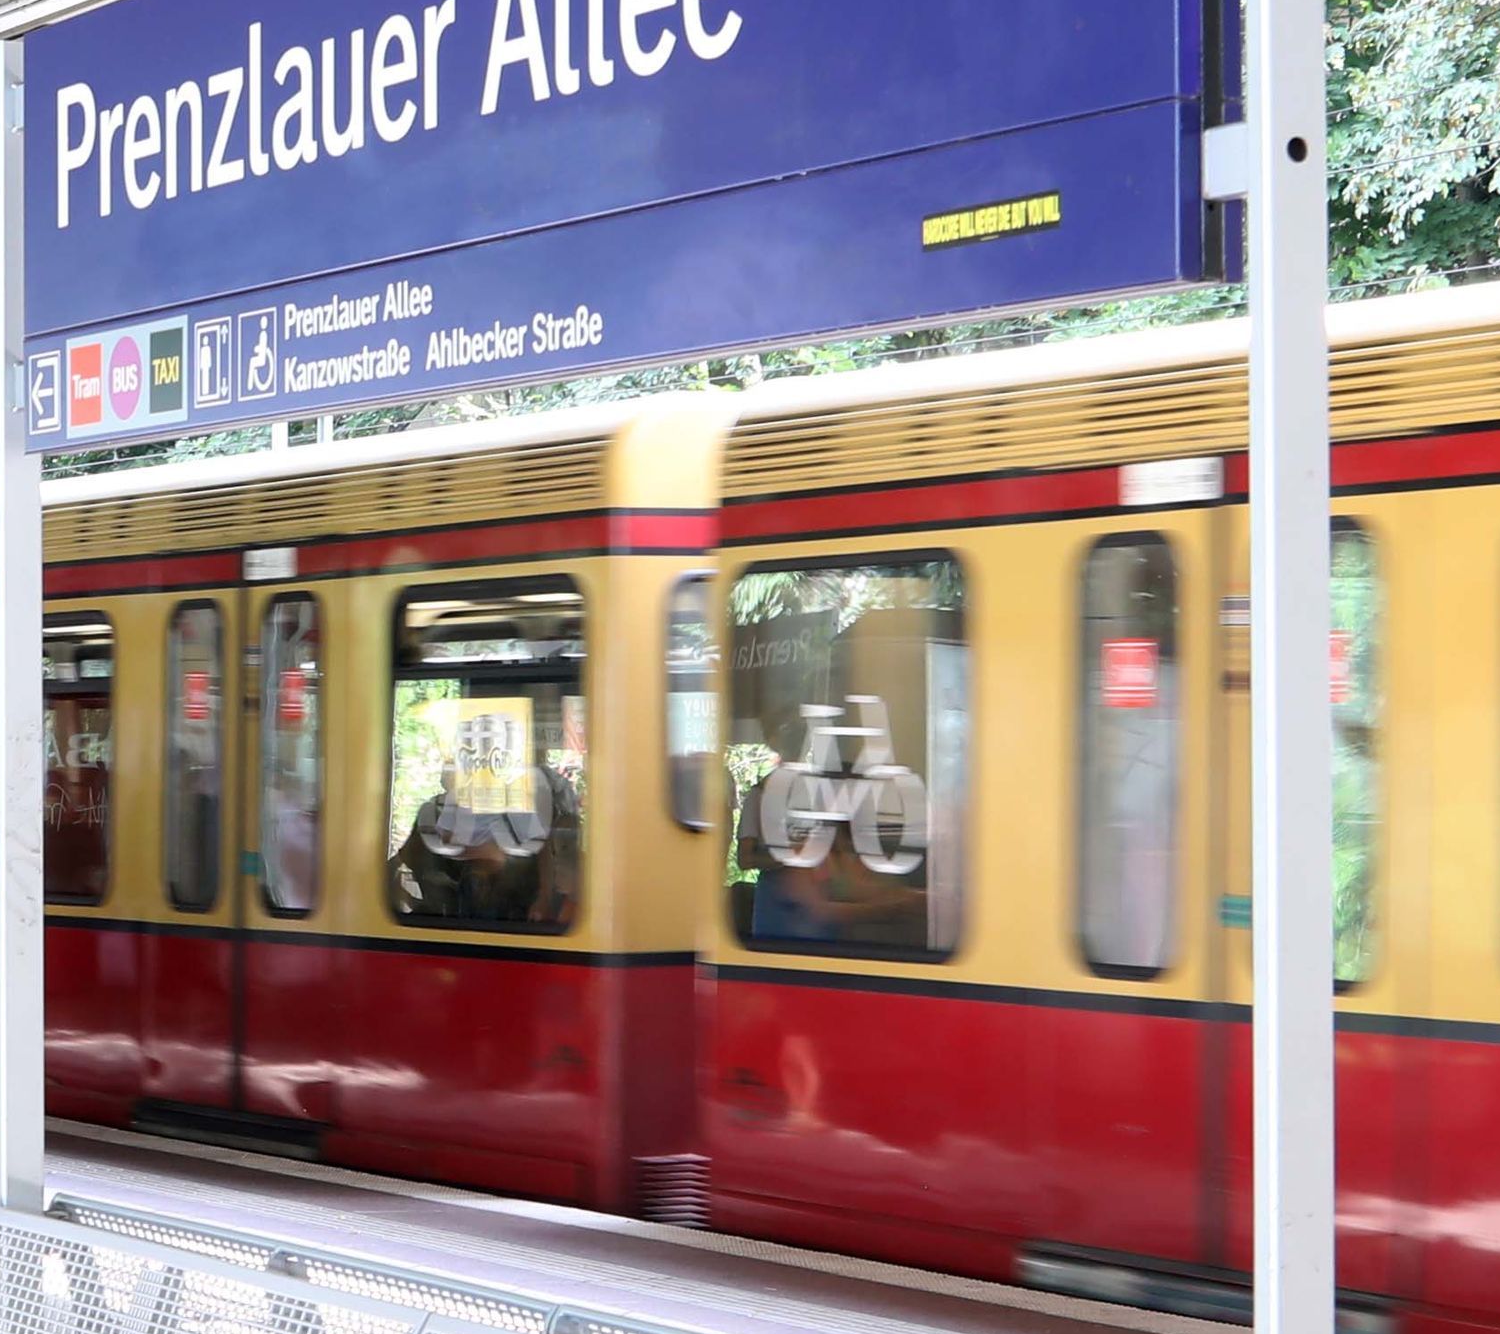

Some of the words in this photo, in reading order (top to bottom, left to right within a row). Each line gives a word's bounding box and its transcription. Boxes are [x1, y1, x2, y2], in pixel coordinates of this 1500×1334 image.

[284, 290, 378, 340] Prenzlauer
[381, 280, 433, 320] Allee
[284, 342, 411, 393] Kanzowstraße
[424, 322, 526, 371] Ahlbecker
[531, 305, 603, 351] Straße
[112, 361, 138, 392] BUS
[152, 355, 179, 385] TAXI
[71, 372, 100, 400] Tram
